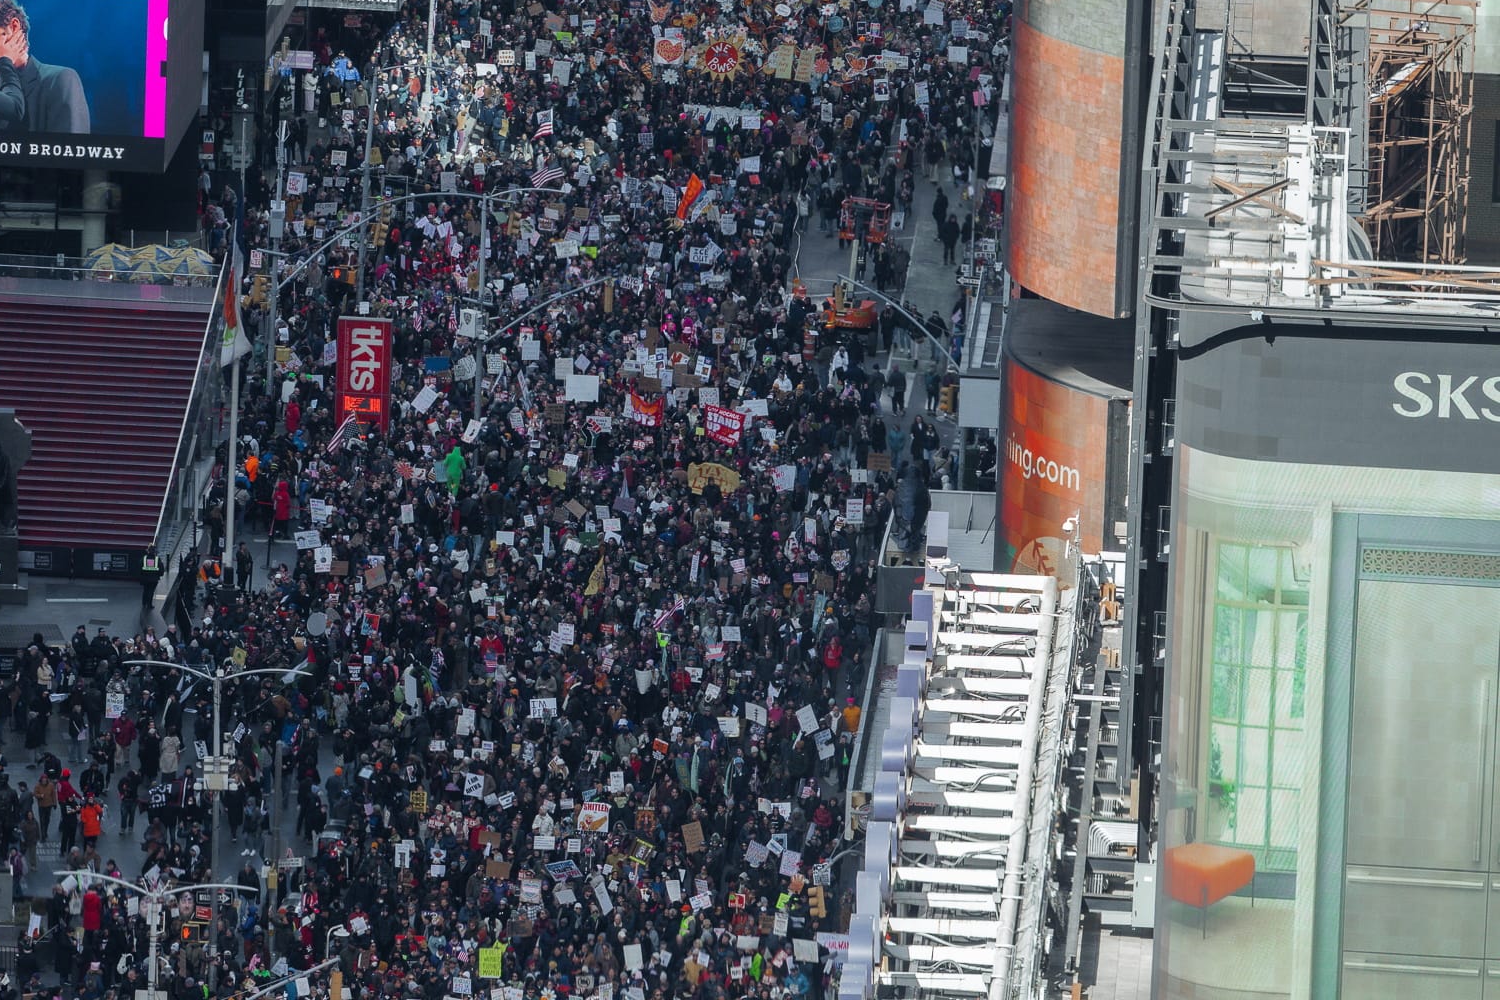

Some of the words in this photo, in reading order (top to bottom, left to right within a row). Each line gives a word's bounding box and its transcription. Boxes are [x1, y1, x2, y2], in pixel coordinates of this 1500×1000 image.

[710, 41, 731, 56] WE
[706, 57, 737, 72] POWER
[0, 142, 22, 155] ON
[29, 144, 126, 160] BROADWAY
[350, 325, 383, 392] tkts
[706, 412, 741, 430] STAND
[706, 421, 721, 432] UP
